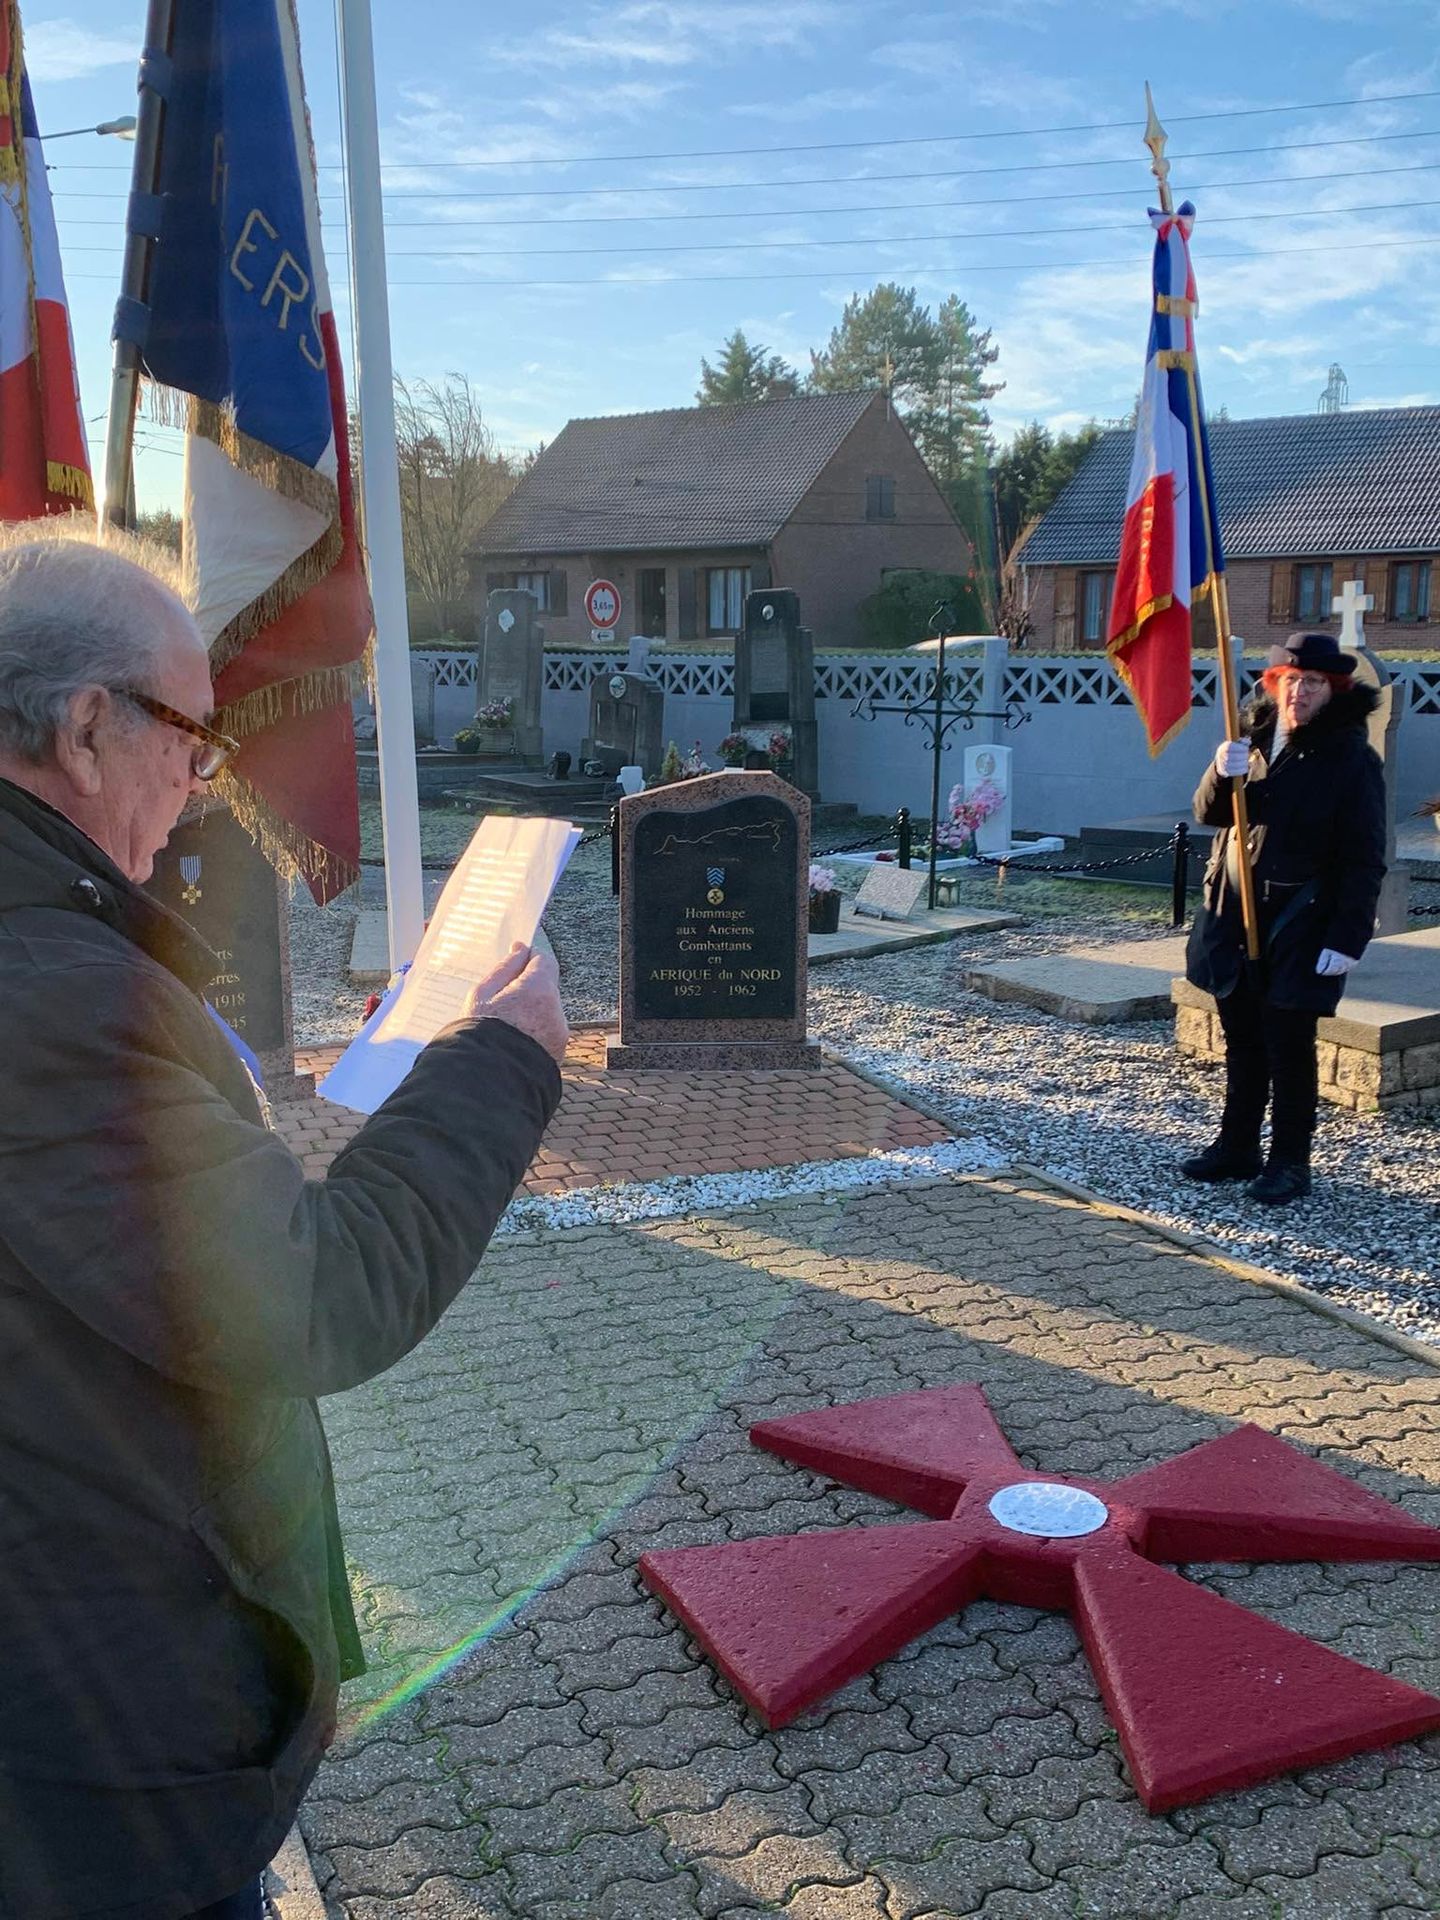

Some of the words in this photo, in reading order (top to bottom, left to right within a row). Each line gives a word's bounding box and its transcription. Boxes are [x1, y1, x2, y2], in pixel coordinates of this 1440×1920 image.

[685, 908, 746, 920] Hommage
[676, 926, 697, 935] aux
[708, 924, 754, 935] Anciens
[679, 940, 752, 951] Combattants
[216, 950, 232, 960] rts
[707, 956, 722, 964] en
[209, 974, 240, 986] erres
[649, 969, 712, 982] AFRIQUE
[718, 969, 733, 980] du
[740, 969, 781, 980] NORD
[674, 985, 702, 996] 1952
[729, 985, 757, 996] 1962
[215, 993, 246, 1009] 1918
